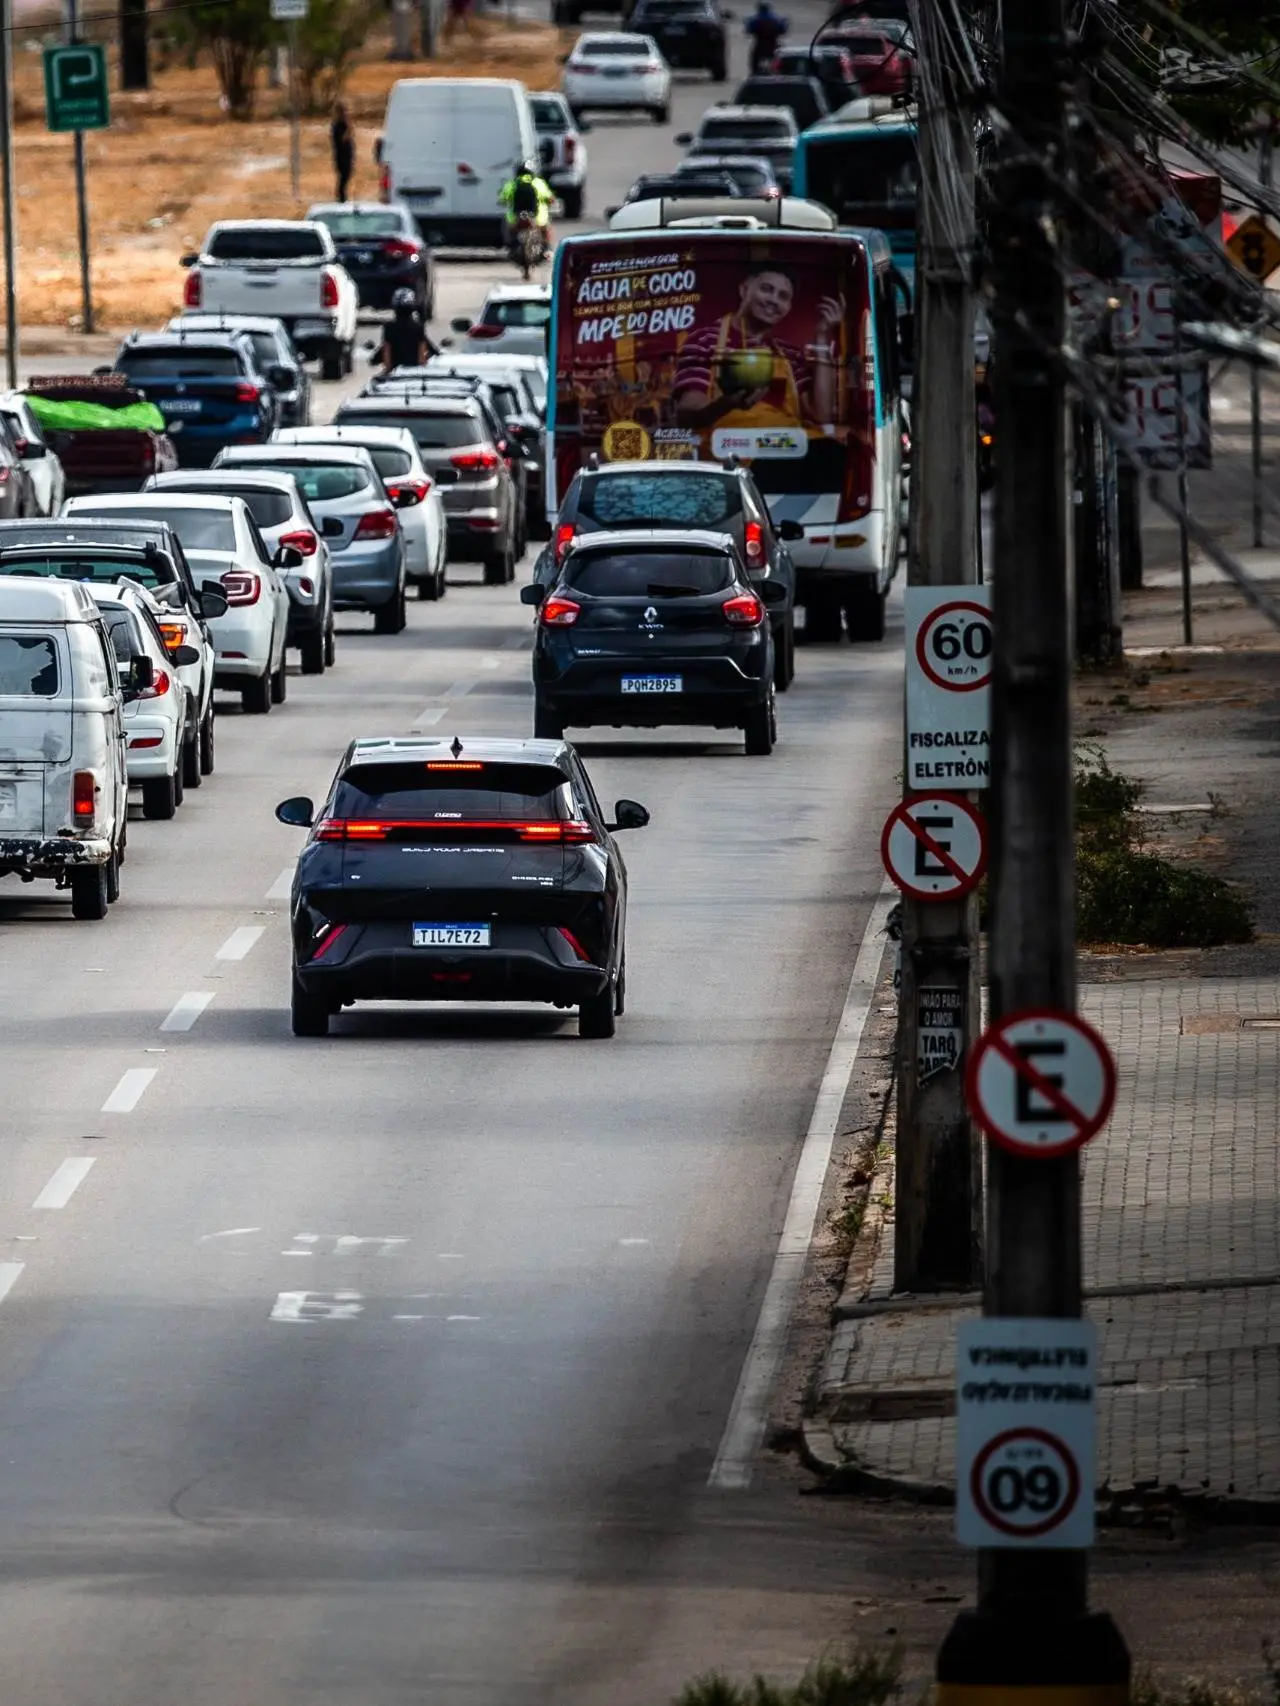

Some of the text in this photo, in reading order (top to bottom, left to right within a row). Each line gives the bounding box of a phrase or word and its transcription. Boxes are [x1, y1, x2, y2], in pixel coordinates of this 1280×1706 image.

[577, 269, 696, 302] ÁGUA DE COCO
[577, 305, 696, 344] MPE DO BNB
[932, 622, 992, 661] 60
[947, 666, 977, 675] km/h
[910, 731, 991, 748] FISCALIZA
[915, 758, 990, 778] ELETRÔN
[915, 817, 953, 876] E
[420, 930, 481, 944] TIL7E72
[932, 1011, 953, 1026] AMOR
[922, 1031, 956, 1054] TARÔ
[1015, 1041, 1067, 1124] E
[988, 1465, 1060, 1513] 60
